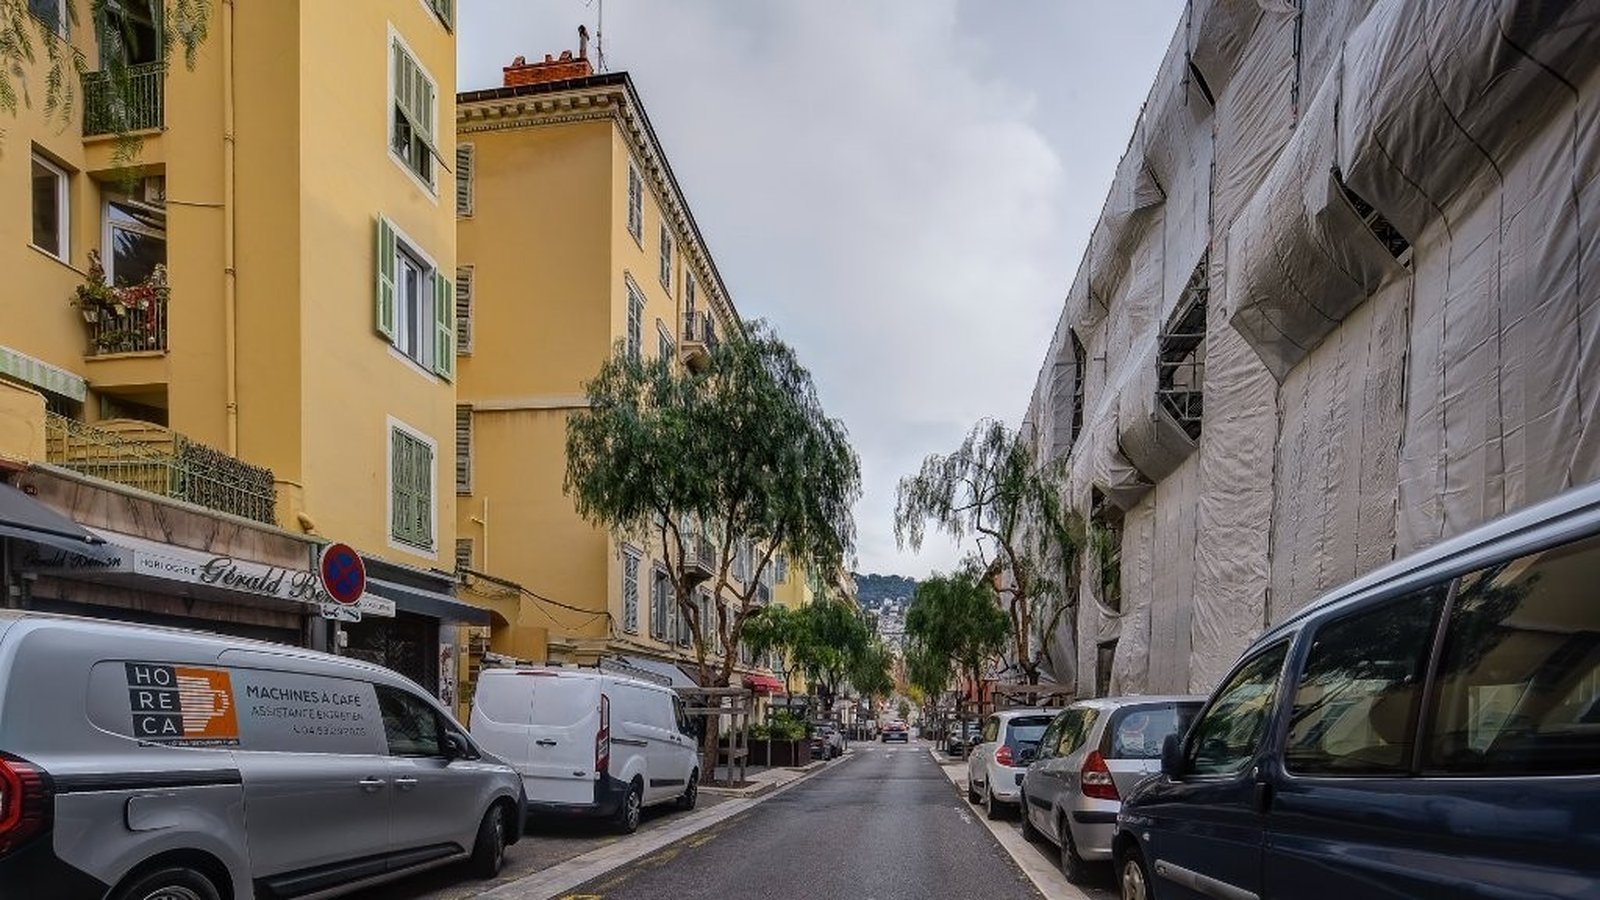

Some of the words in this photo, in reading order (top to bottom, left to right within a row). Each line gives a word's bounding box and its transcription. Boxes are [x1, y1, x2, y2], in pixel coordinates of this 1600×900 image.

[200, 557, 286, 597] Gérald
[135, 666, 170, 685] HO
[139, 691, 173, 709] RE
[246, 684, 319, 704] MACHINES
[332, 692, 362, 707] CAFÉ
[142, 716, 178, 734] CA
